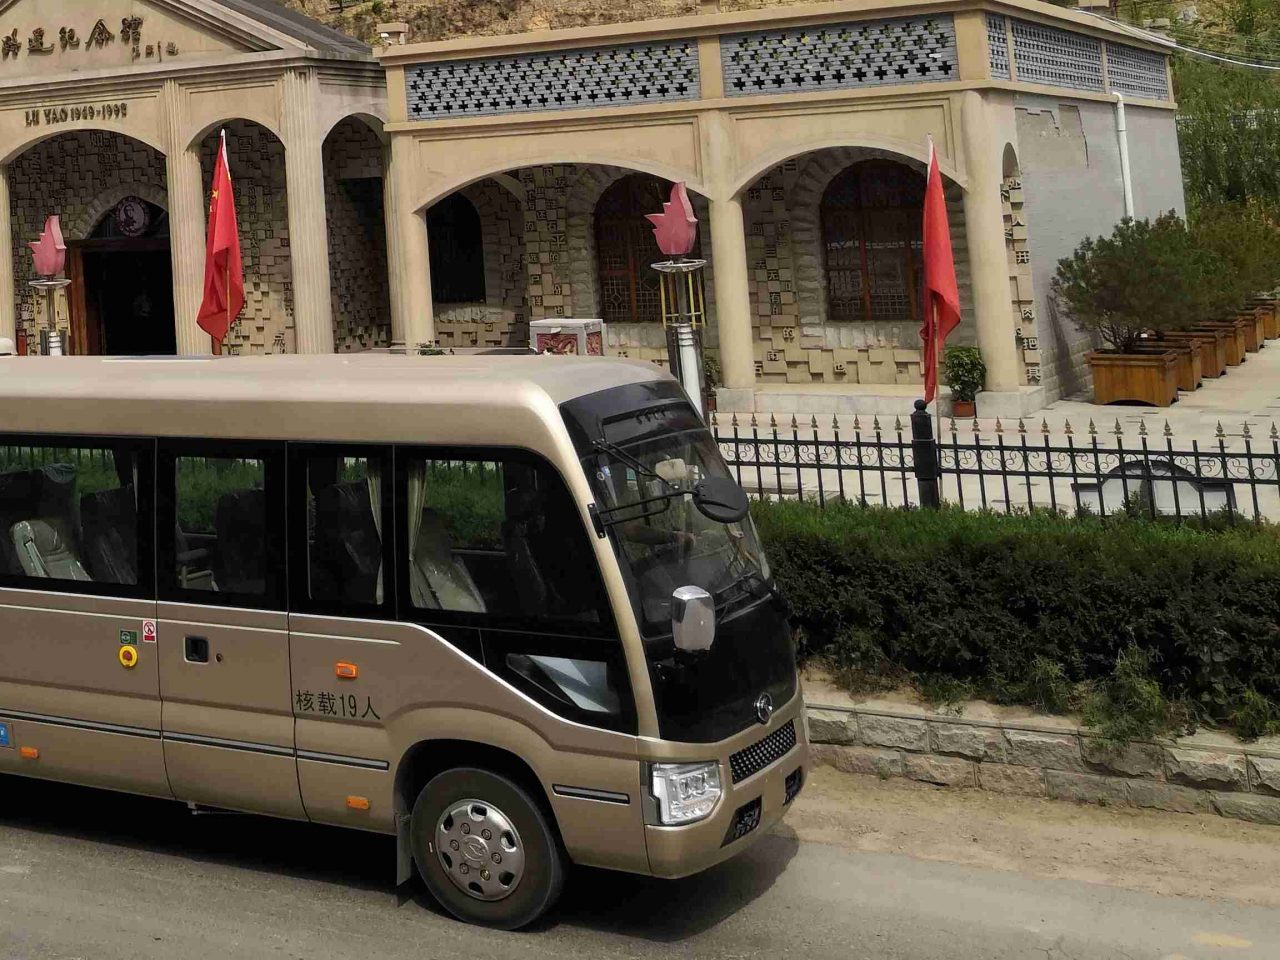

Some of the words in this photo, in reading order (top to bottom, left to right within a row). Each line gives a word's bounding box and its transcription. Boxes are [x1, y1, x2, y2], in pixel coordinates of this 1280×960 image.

[43, 107, 68, 125] YAO
[296, 689, 381, 720] 核载19人
